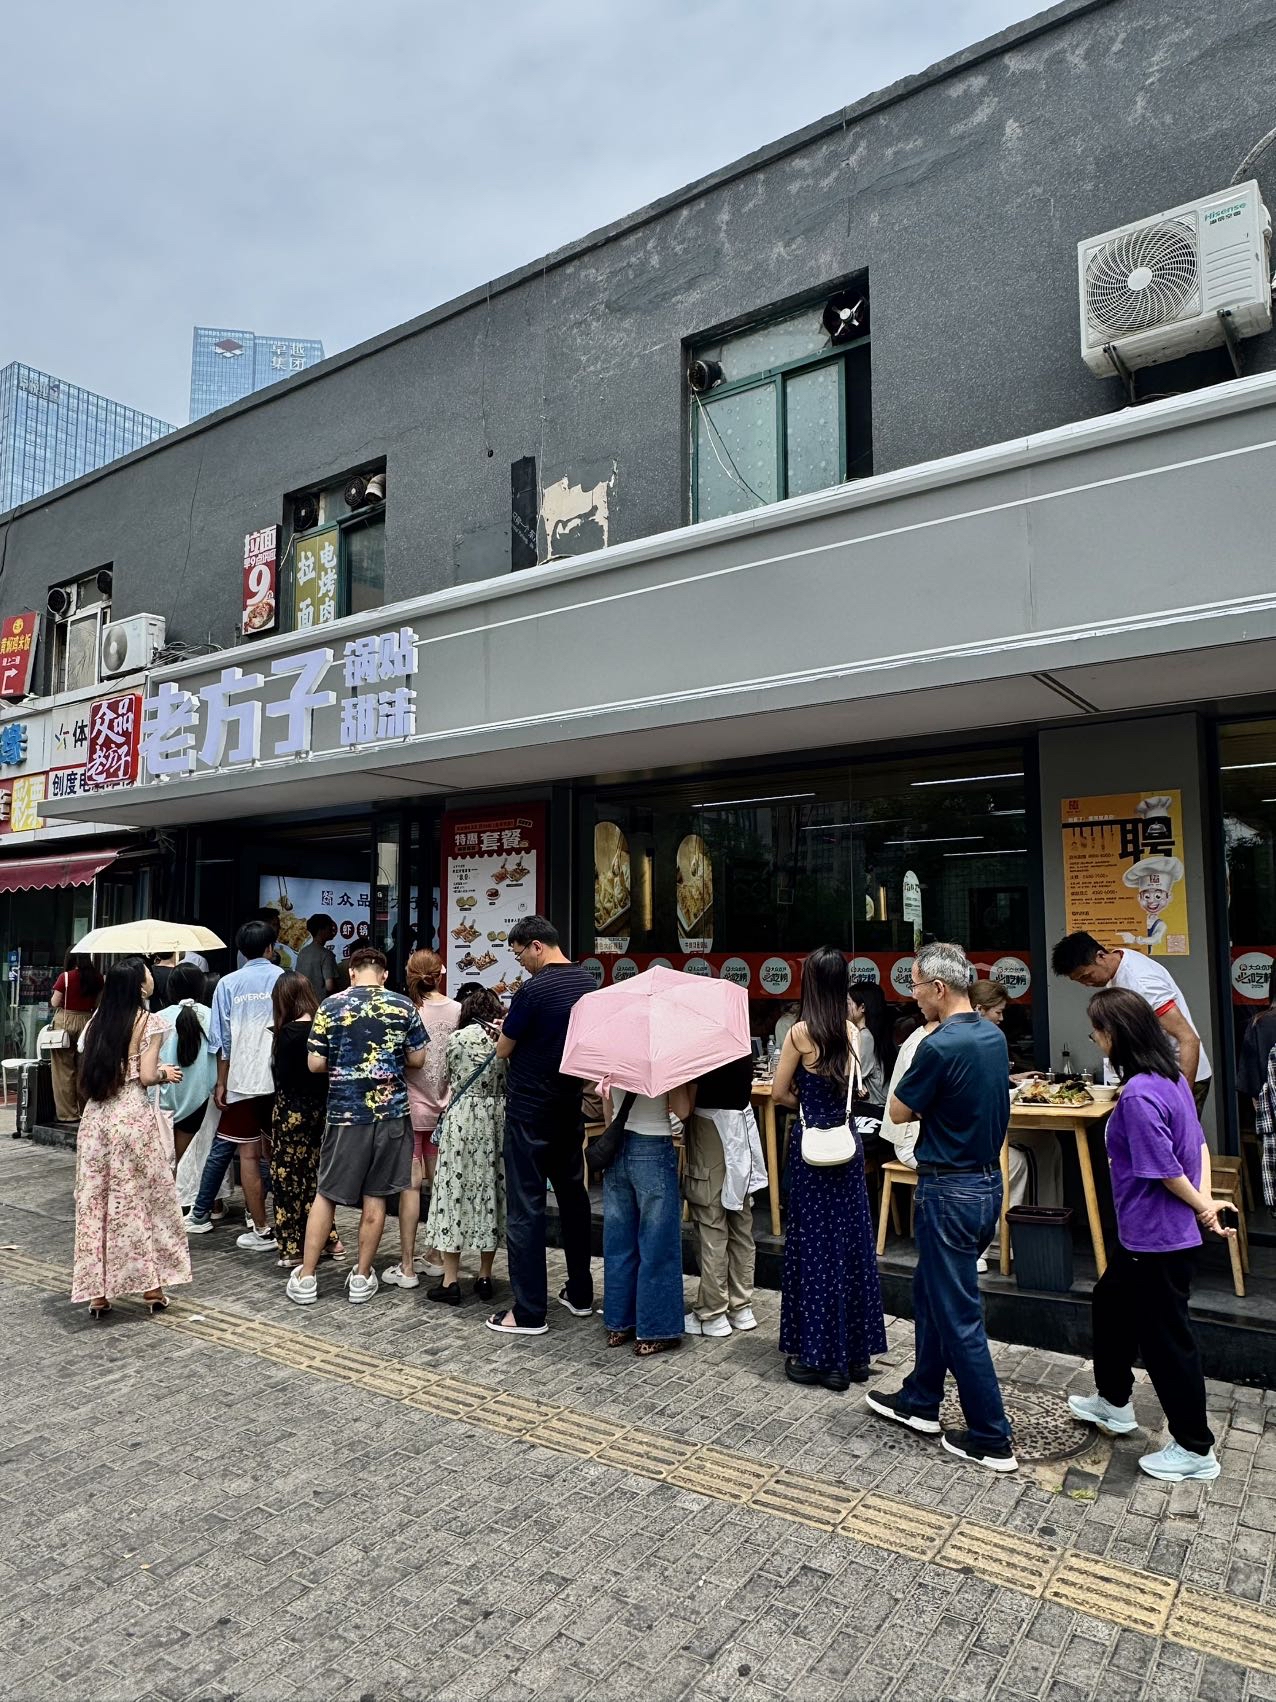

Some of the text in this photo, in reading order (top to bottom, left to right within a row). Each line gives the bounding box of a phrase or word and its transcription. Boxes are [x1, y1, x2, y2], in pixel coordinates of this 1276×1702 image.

[1205, 203, 1246, 222] Hisense
[272, 343, 306, 356] 卓越
[272, 357, 305, 371] 集团
[244, 525, 277, 558] 拉面
[247, 564, 271, 606] 9
[297, 551, 316, 630] 拉面
[343, 626, 419, 689] 锅贴
[139, 646, 337, 775] 老方子
[86, 743, 131, 782] 老方子
